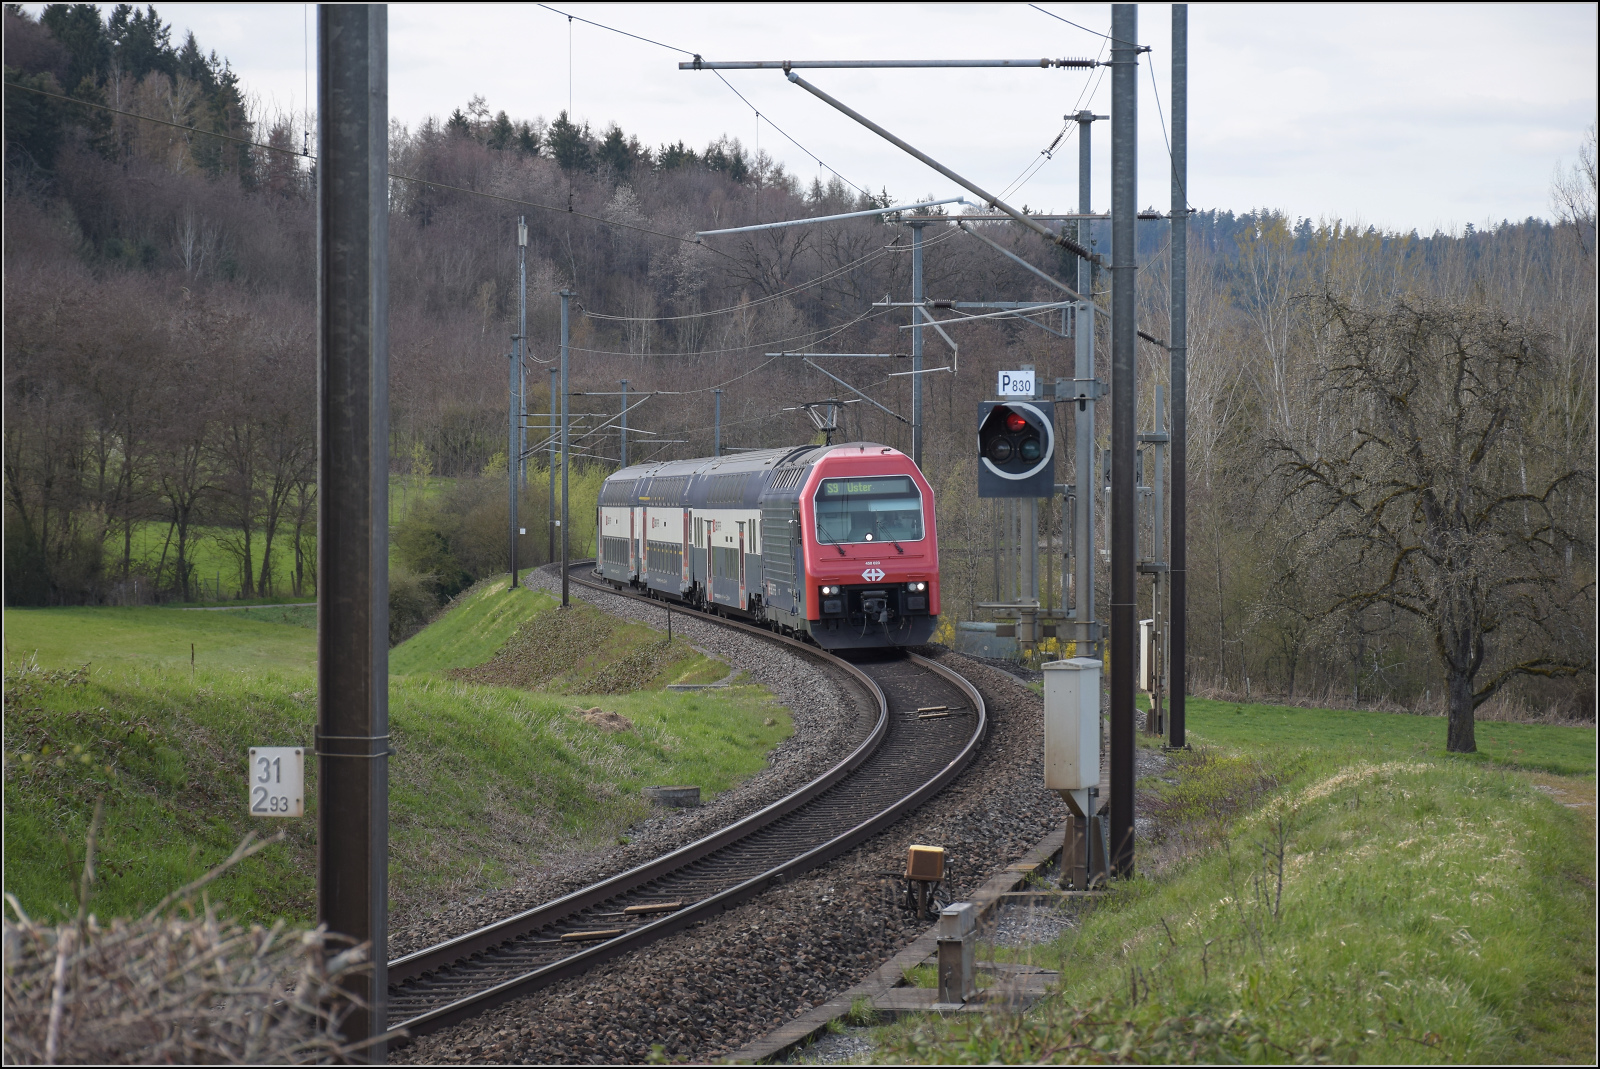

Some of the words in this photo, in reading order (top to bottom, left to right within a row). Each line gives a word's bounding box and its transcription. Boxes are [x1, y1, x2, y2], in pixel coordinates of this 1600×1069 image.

[827, 483, 839, 493] S9
[847, 482, 872, 492] Uster
[257, 756, 280, 783] 31
